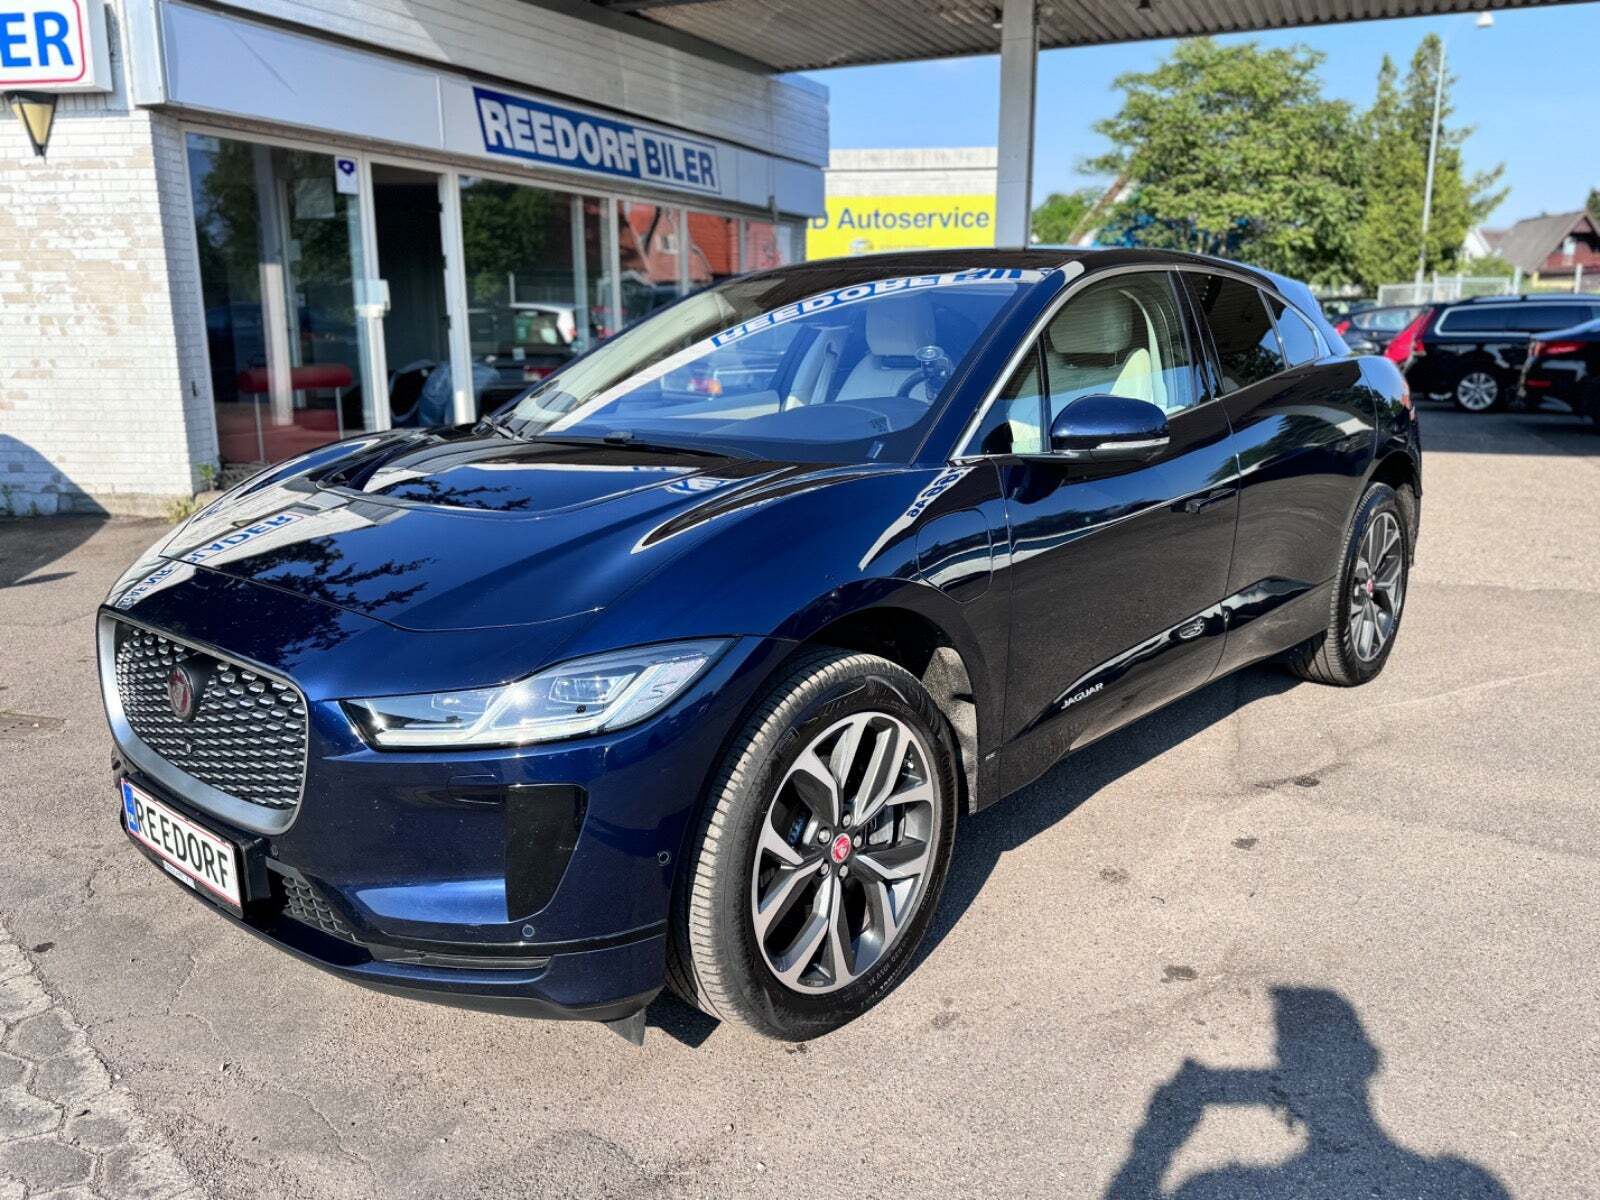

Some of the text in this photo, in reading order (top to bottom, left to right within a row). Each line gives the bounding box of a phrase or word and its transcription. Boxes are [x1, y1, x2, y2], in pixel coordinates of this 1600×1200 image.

[0, 11, 74, 67] ER
[480, 98, 716, 187] REEDORF BILER
[837, 206, 990, 230] Autoservice
[1061, 682, 1104, 710] JAGUAR
[134, 797, 229, 888] REEDORF
